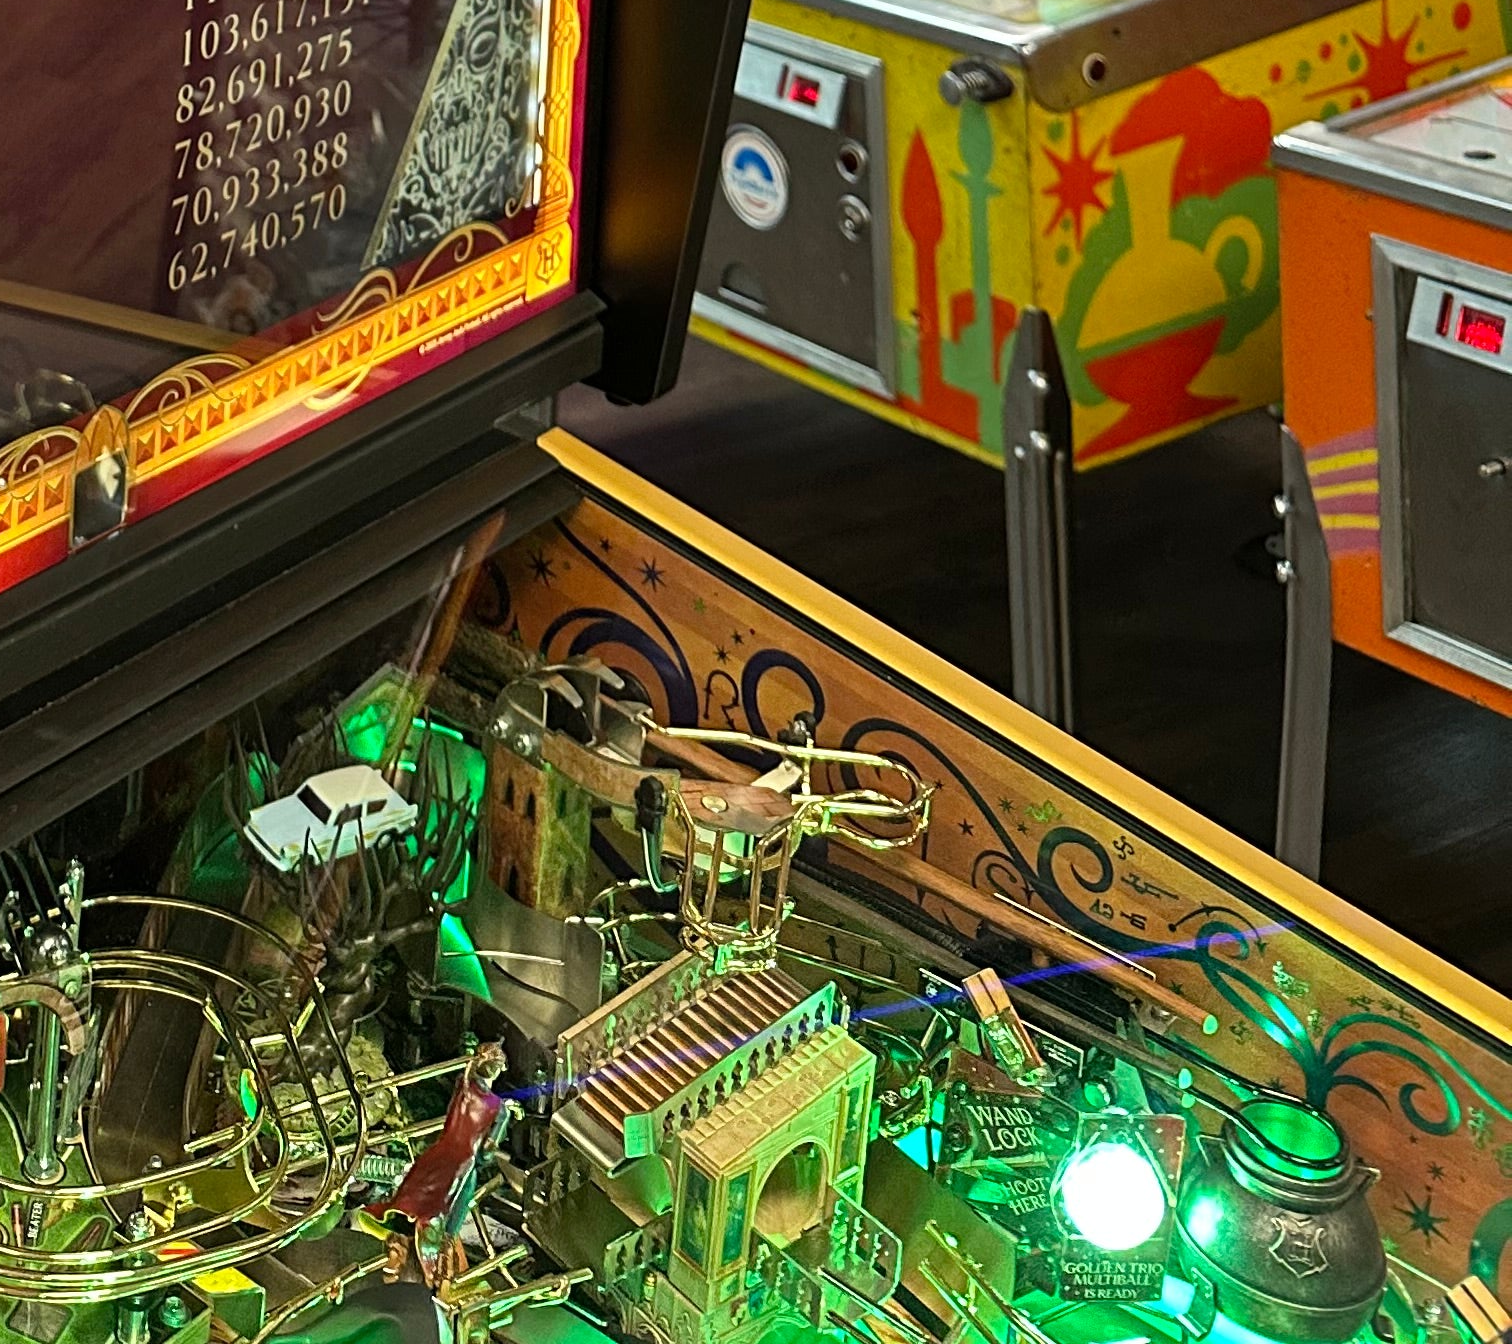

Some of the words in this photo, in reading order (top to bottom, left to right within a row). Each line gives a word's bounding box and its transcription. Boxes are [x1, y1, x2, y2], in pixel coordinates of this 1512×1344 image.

[175, 28, 353, 124] 82,691,275
[173, 80, 352, 180] 78,720,930
[171, 131, 349, 237] 70,933,388
[167, 183, 347, 292] 62,740,570
[966, 1105, 1035, 1127] WAND
[981, 1126, 1043, 1152] LOCK
[999, 1176, 1048, 1199] HOOT
[1008, 1193, 1050, 1216] HERE
[27, 1201, 44, 1240] BEATER
[1064, 1261, 1126, 1275] GOLDEN
[1128, 1262, 1165, 1276] TRIO
[1073, 1273, 1154, 1287] MULTIBALL
[1083, 1287, 1096, 1300] IS
[1097, 1287, 1141, 1300] READY
